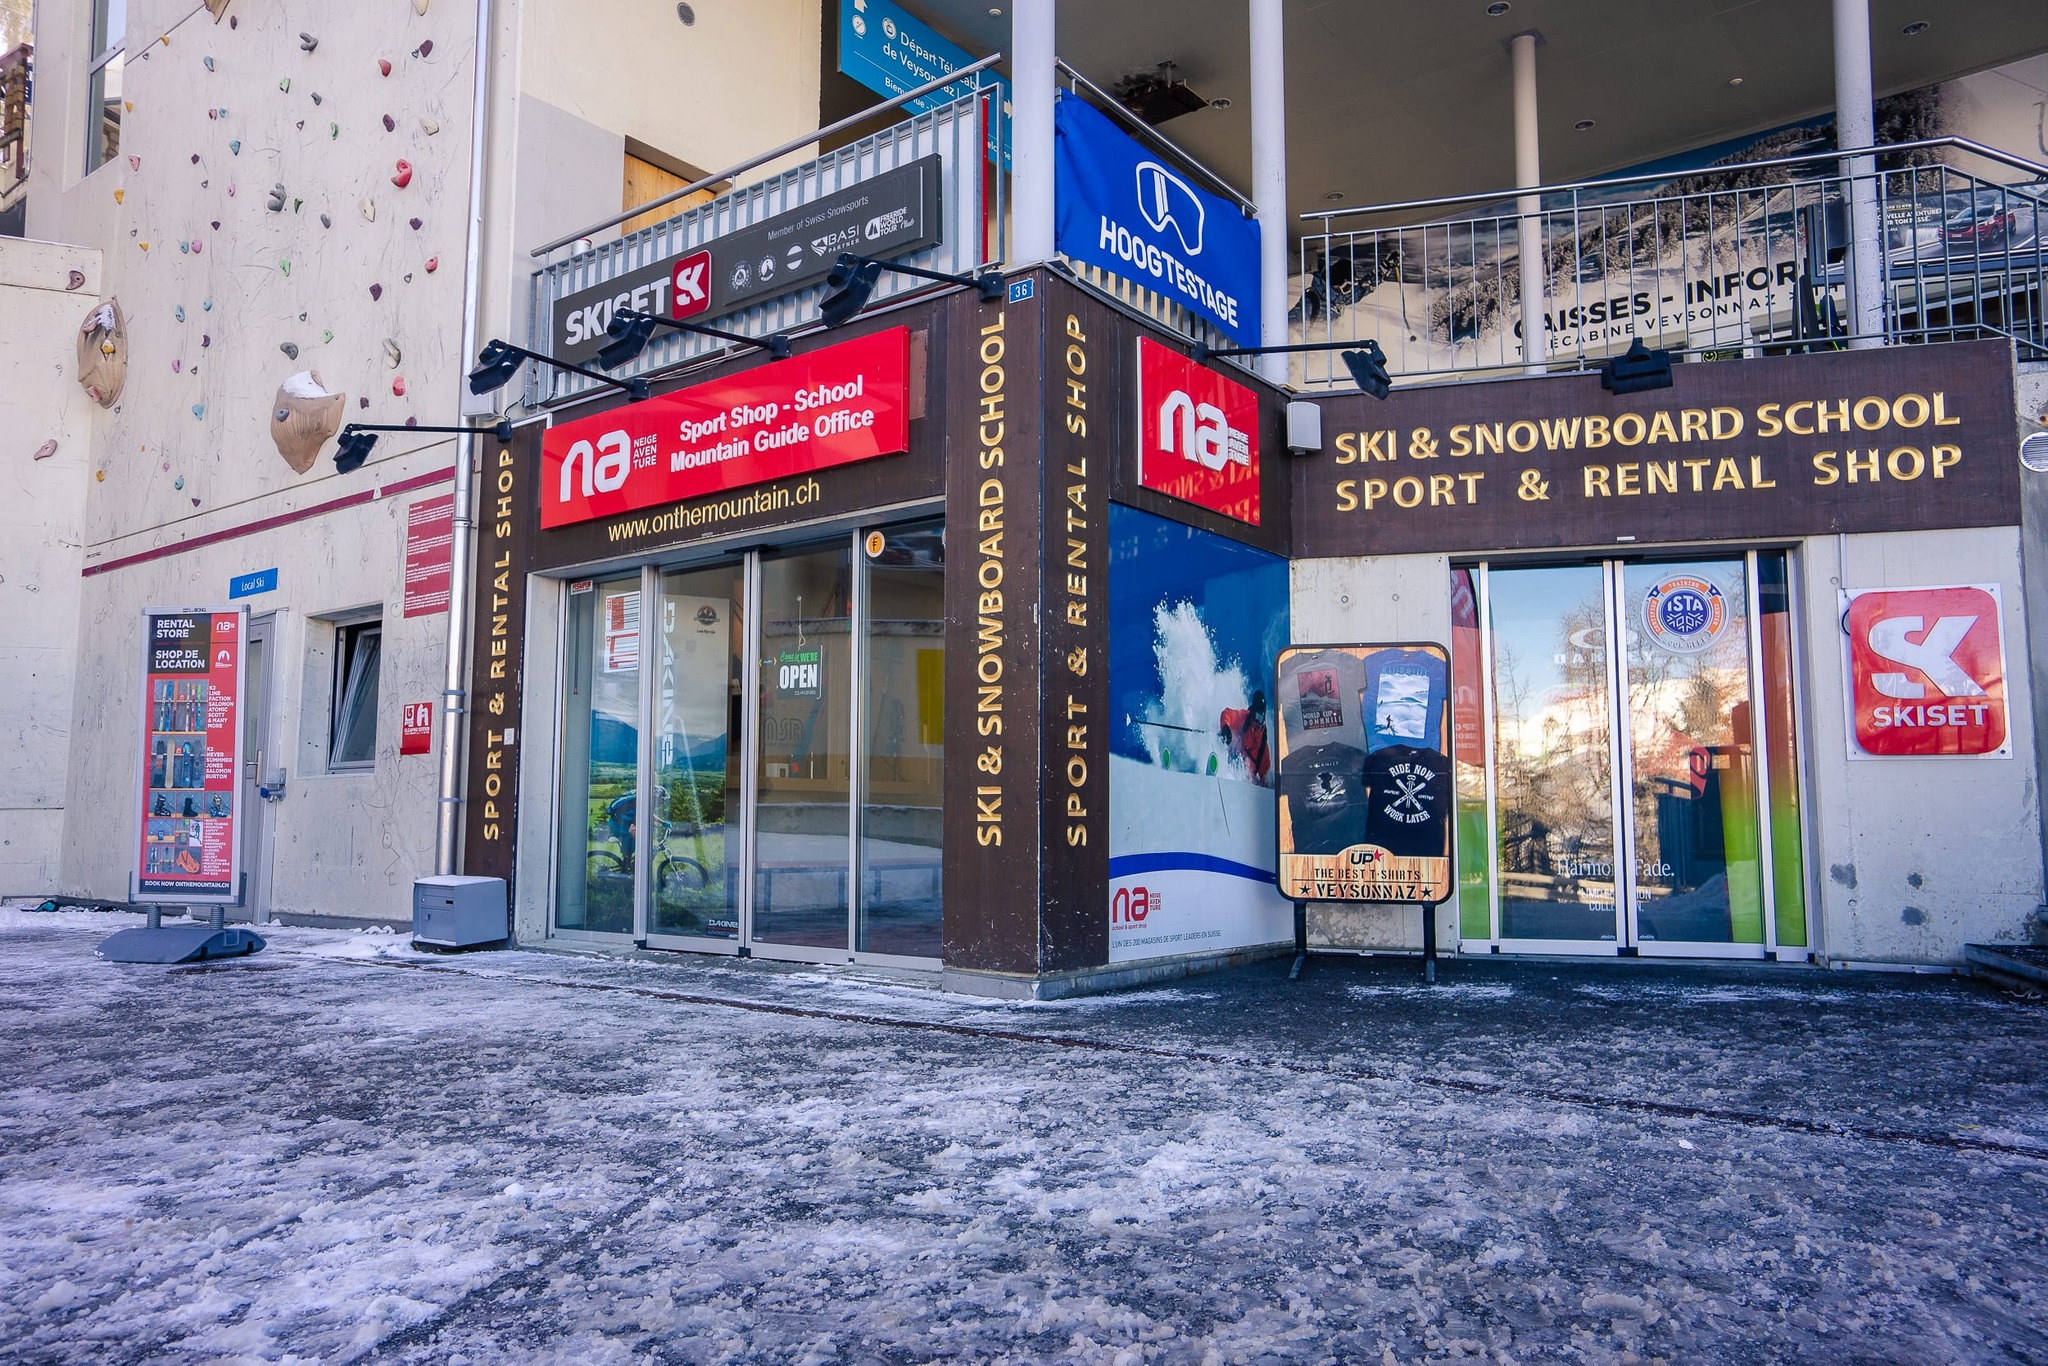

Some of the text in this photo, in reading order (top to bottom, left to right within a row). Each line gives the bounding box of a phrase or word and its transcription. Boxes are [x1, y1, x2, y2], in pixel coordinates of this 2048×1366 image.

[883, 43, 898, 60] de
[900, 31, 937, 66] Départ
[768, 196, 869, 241] Member of Swiss Snowsports
[880, 206, 908, 222] FREERIDE
[880, 216, 904, 228] WORLD
[828, 225, 860, 246] BASI
[880, 225, 898, 236] TOUR
[828, 238, 860, 254] PARTNER
[1100, 214, 1239, 328] HOOGTESTAGE
[676, 262, 706, 306] SK
[1015, 283, 1028, 298] 36
[1645, 293, 1777, 330] VEYSONNAZ
[680, 412, 727, 443] Sport
[730, 401, 778, 428] Shop
[794, 374, 863, 410] School
[1160, 390, 1249, 472] na NEIGE
[1334, 391, 1961, 465] SKI & SNOWBOARD SCHOOL
[670, 408, 875, 473] Mountain Guide Office
[1228, 437, 1249, 456] AVEN
[633, 444, 657, 459] AVEN
[1228, 450, 1249, 466] TURE
[560, 429, 657, 503] na NEIGE
[633, 456, 657, 470] TURE
[1336, 444, 1962, 512] SPORT & RENTAL SHOP
[608, 477, 821, 542] www.onthemountain.ch
[242, 576, 264, 592] Local Ski
[977, 312, 1005, 847] SKI & SNOWBOARD SCHOOL
[1066, 314, 1087, 847] SPORT & RENTAL SHOP
[156, 629, 190, 638] STORE
[157, 620, 196, 628] RENTAL
[484, 448, 514, 841] SPORT & RENTAL SHOP
[156, 650, 198, 659] SHOP DE
[156, 660, 205, 668] LOCATION
[1554, 650, 1655, 664] OAKEY
[1867, 615, 1988, 700] SK
[779, 664, 818, 690] OPEN
[1304, 711, 1320, 720] WORLD
[1872, 704, 1989, 728] SKISET
[1388, 763, 1436, 782] RIDE NOW
[1384, 804, 1430, 824] WORK LATER
[1350, 852, 1374, 865] UP
[1636, 858, 1675, 877] Fade.
[1314, 868, 1334, 878] THE
[1338, 868, 1365, 880] BEST
[1316, 883, 1416, 900] VEYSONNAZ
[1112, 886, 1149, 924] na
[708, 919, 738, 928] DAKINE
[1138, 922, 1148, 930] shop
[1140, 936, 1163, 946] MAGASINS
[1164, 936, 1170, 944] DE
[1170, 934, 1182, 943] SPORT
[1184, 932, 1202, 940] LEADERS
[1208, 930, 1222, 938] SUISSE
